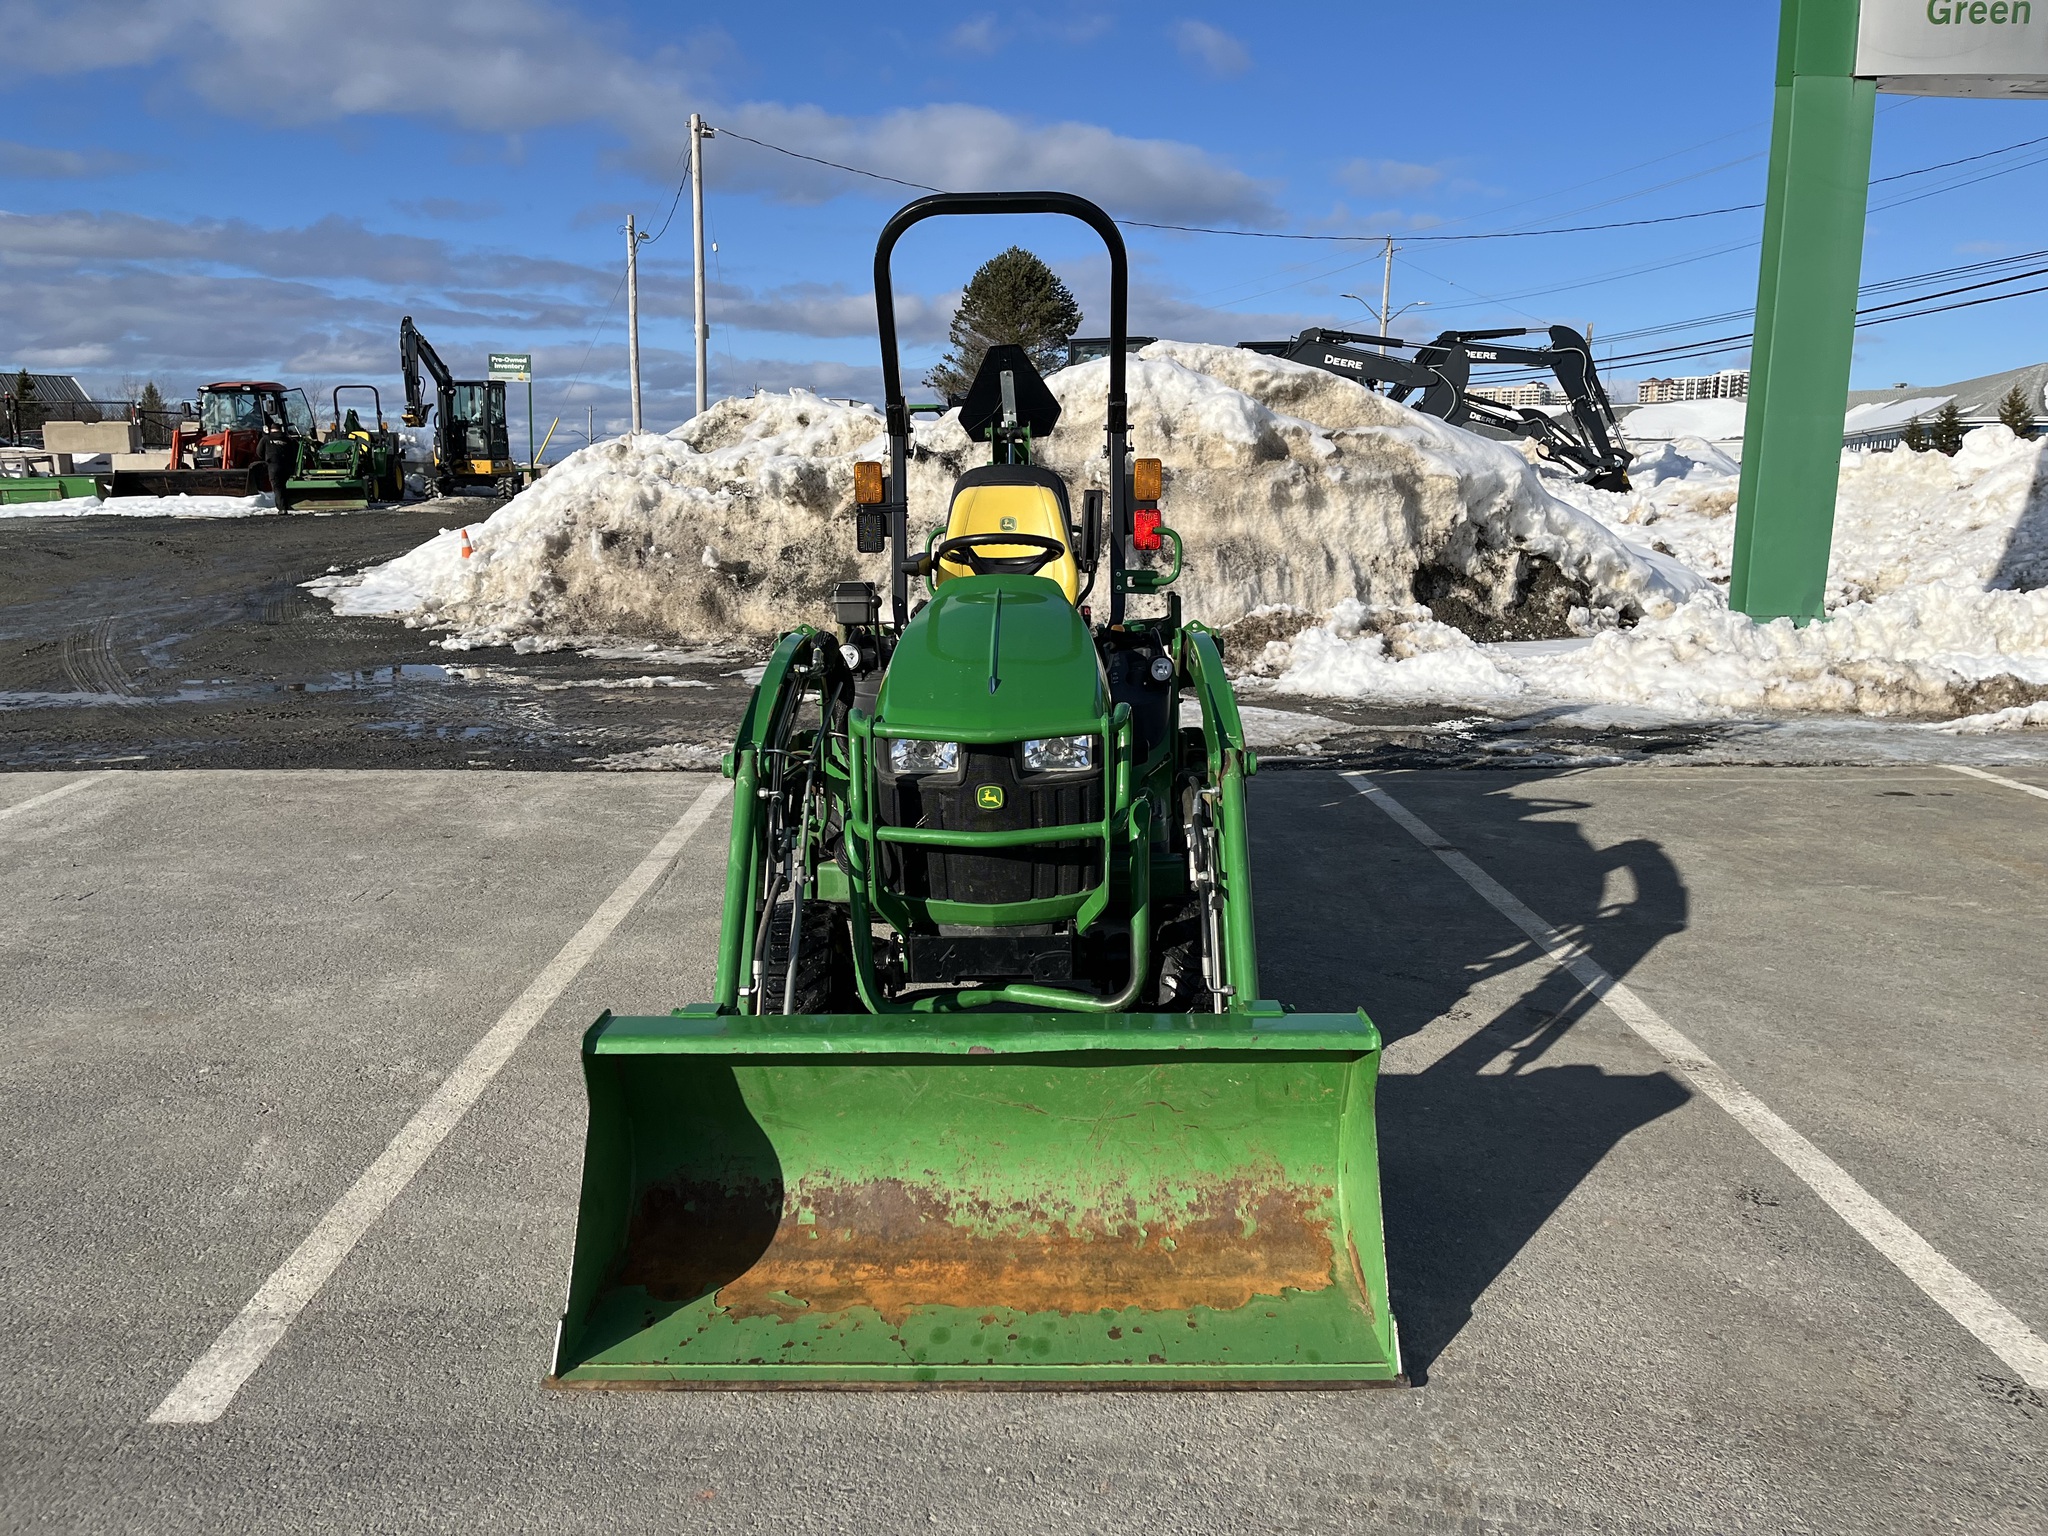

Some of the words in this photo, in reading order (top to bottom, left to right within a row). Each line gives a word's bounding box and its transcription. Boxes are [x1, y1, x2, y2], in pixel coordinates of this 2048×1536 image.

[1927, 0, 2031, 25] Green
[494, 363, 525, 371] Inventory
[1323, 354, 1364, 370] DEERE
[1469, 411, 1497, 425] DEERE
